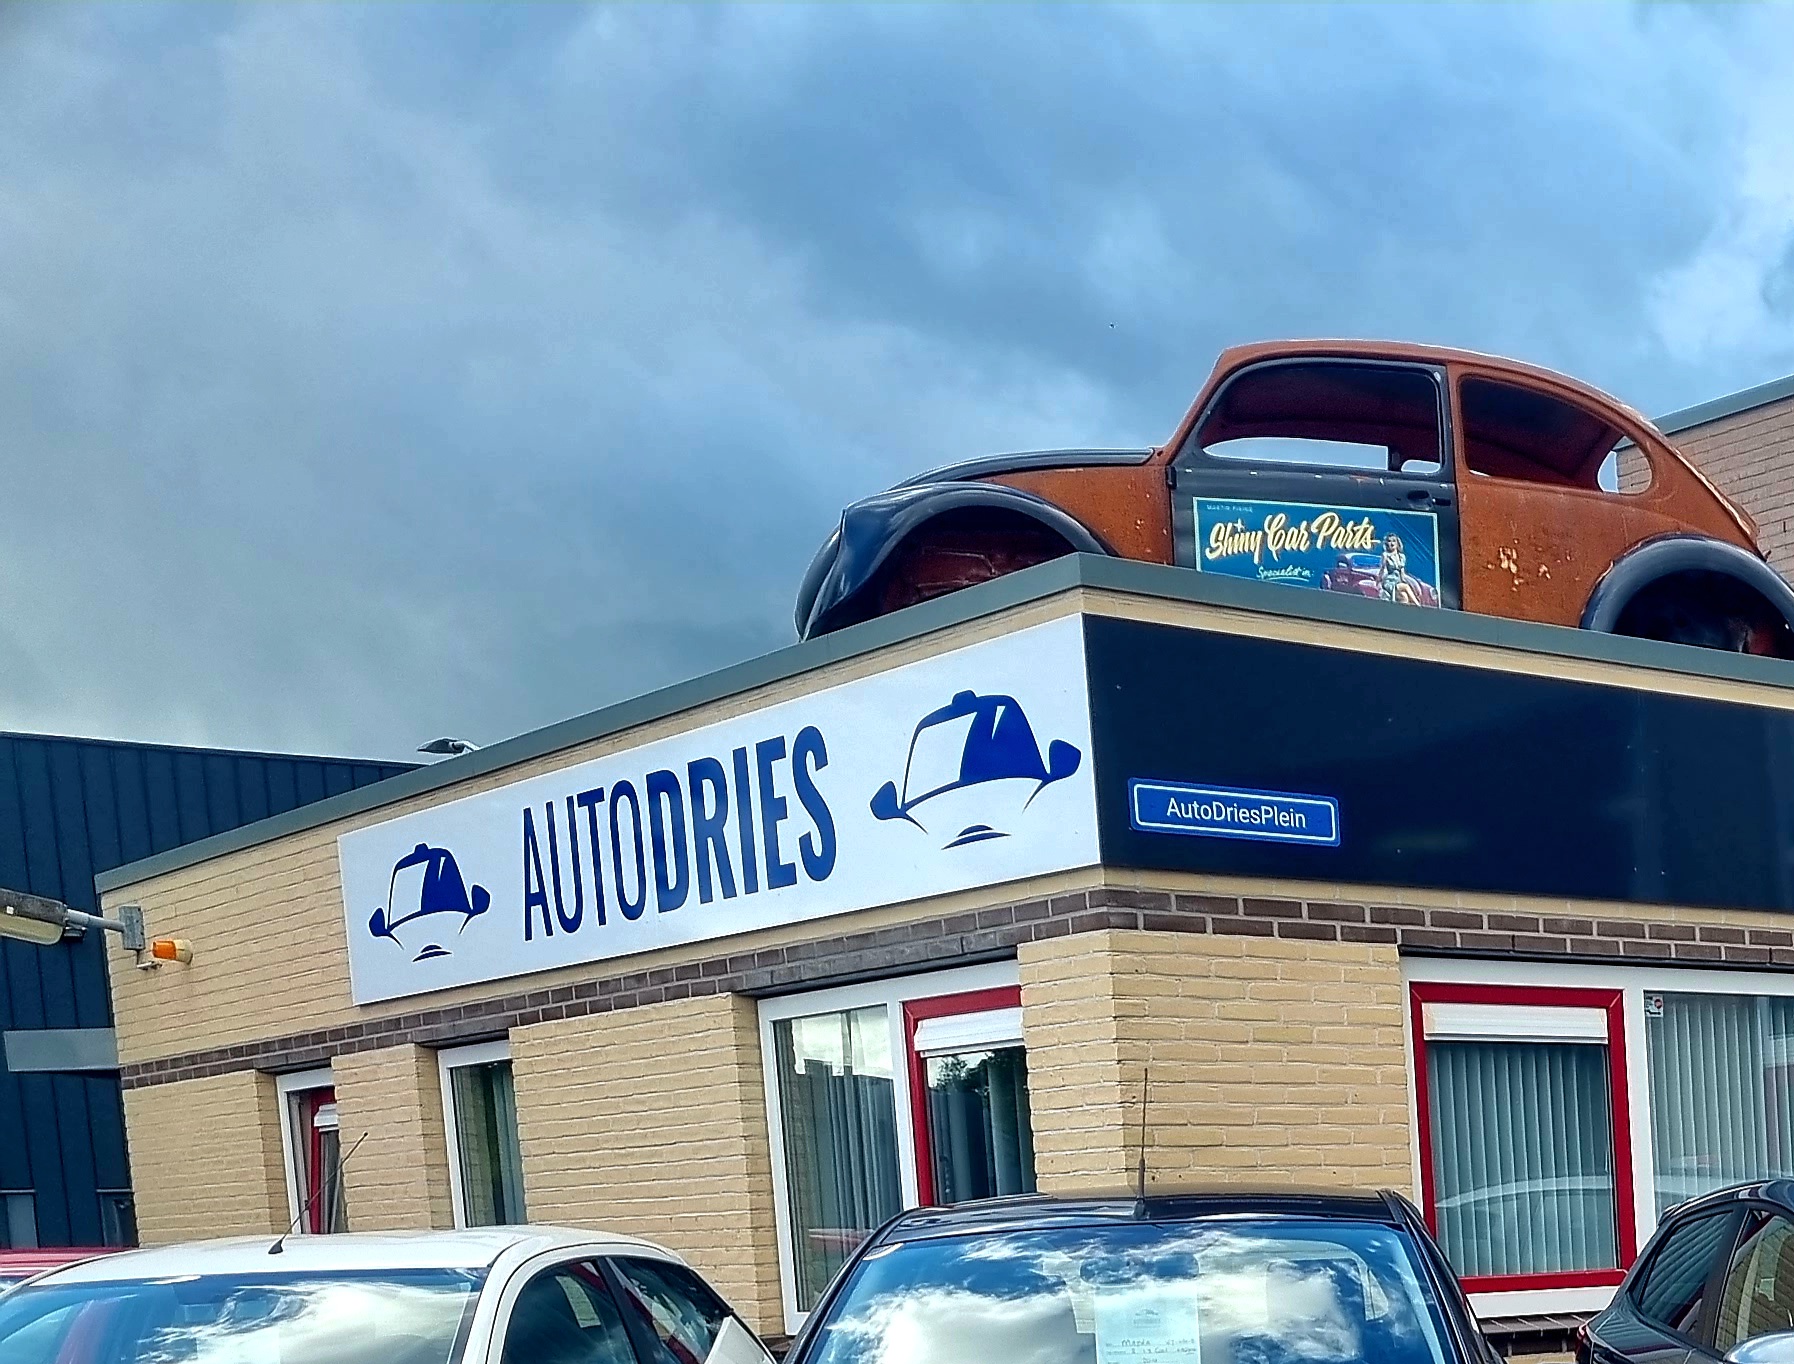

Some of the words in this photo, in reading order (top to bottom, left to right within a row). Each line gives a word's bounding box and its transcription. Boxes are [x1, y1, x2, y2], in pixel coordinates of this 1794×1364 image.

[1205, 518, 1263, 565] Shiny
[1263, 513, 1309, 562] Car
[1310, 512, 1381, 550] Parts
[523, 725, 838, 942] AUTODRIES
[1166, 796, 1307, 829] AutoDriesPlein
